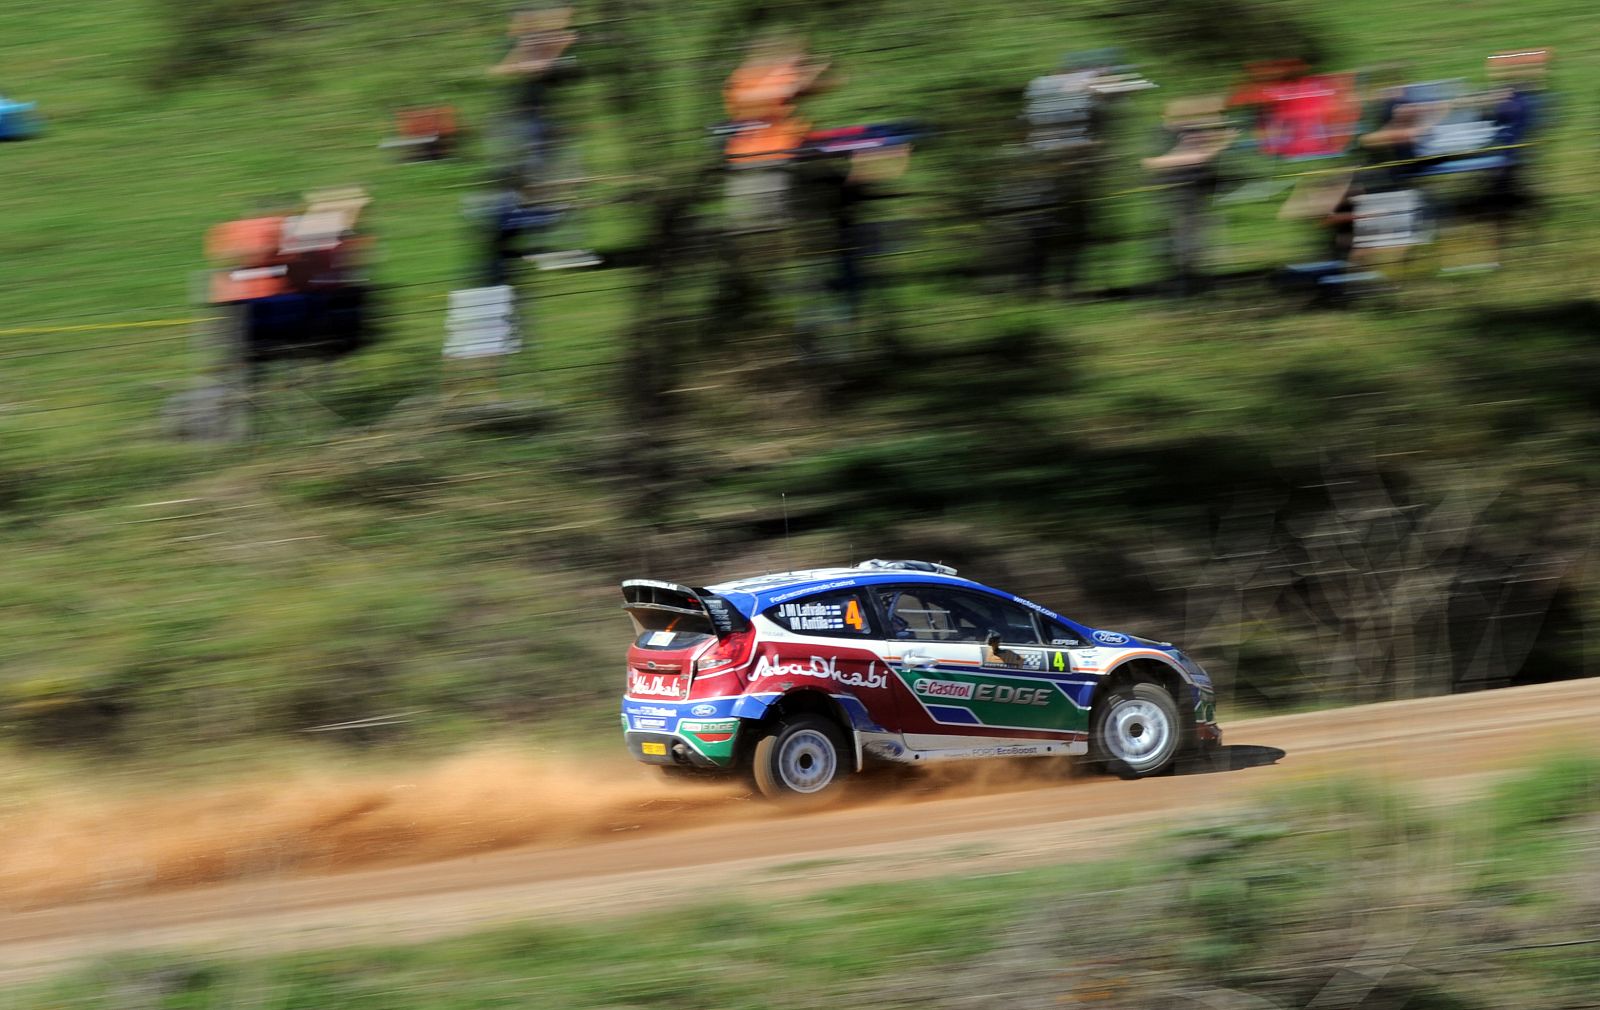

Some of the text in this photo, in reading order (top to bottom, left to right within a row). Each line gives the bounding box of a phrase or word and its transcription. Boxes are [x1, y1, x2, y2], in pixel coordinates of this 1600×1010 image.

[778, 604, 786, 617] J
[785, 603, 796, 617] M
[845, 600, 863, 630] 4
[789, 616, 801, 630] M
[1099, 632, 1123, 644] Ford
[1053, 651, 1065, 672] 4
[928, 681, 1053, 706] Castrol EDGE
[997, 747, 1038, 755] EcoBoost
